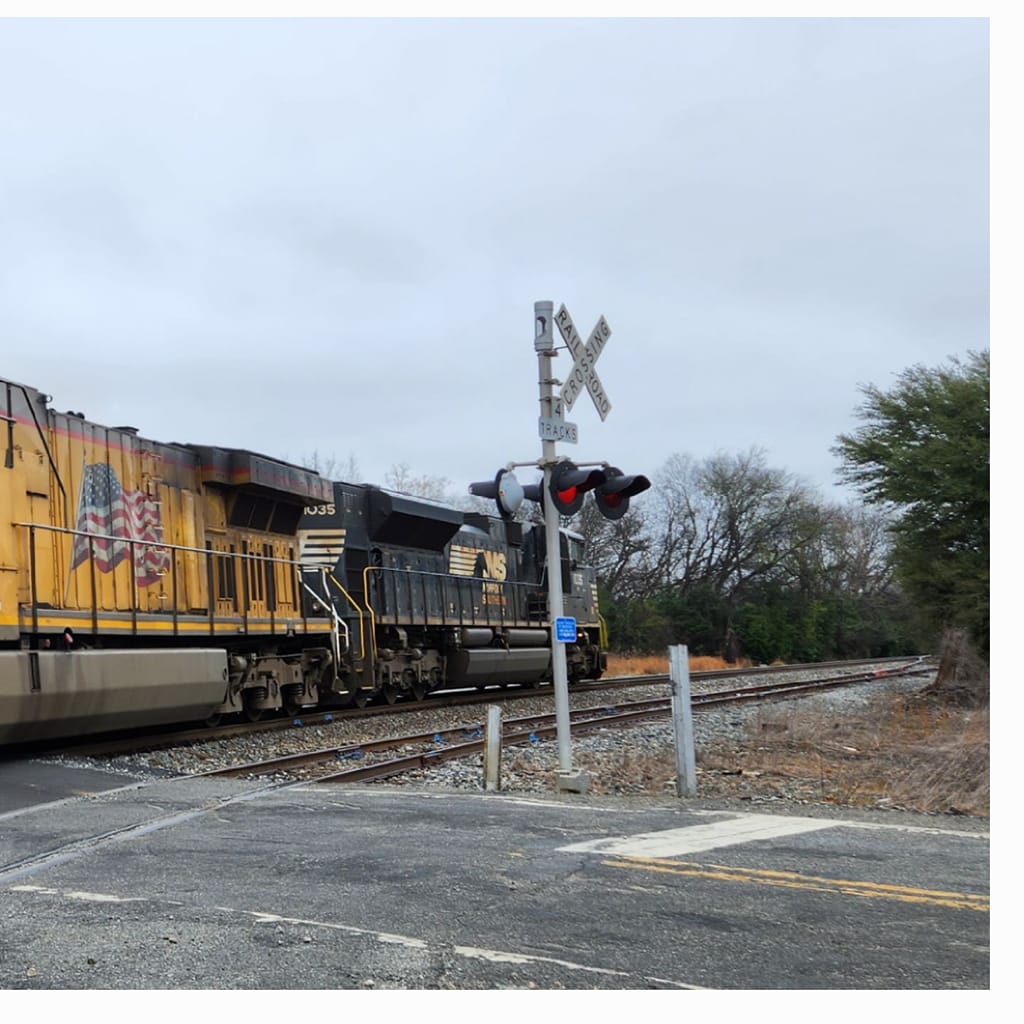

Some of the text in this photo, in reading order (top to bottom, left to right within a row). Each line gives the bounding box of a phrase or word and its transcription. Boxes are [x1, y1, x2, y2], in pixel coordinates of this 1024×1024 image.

[563, 322, 609, 405] CROSSING
[555, 403, 561, 417] 4
[541, 423, 577, 441] TRACKS
[304, 504, 336, 516] 1035
